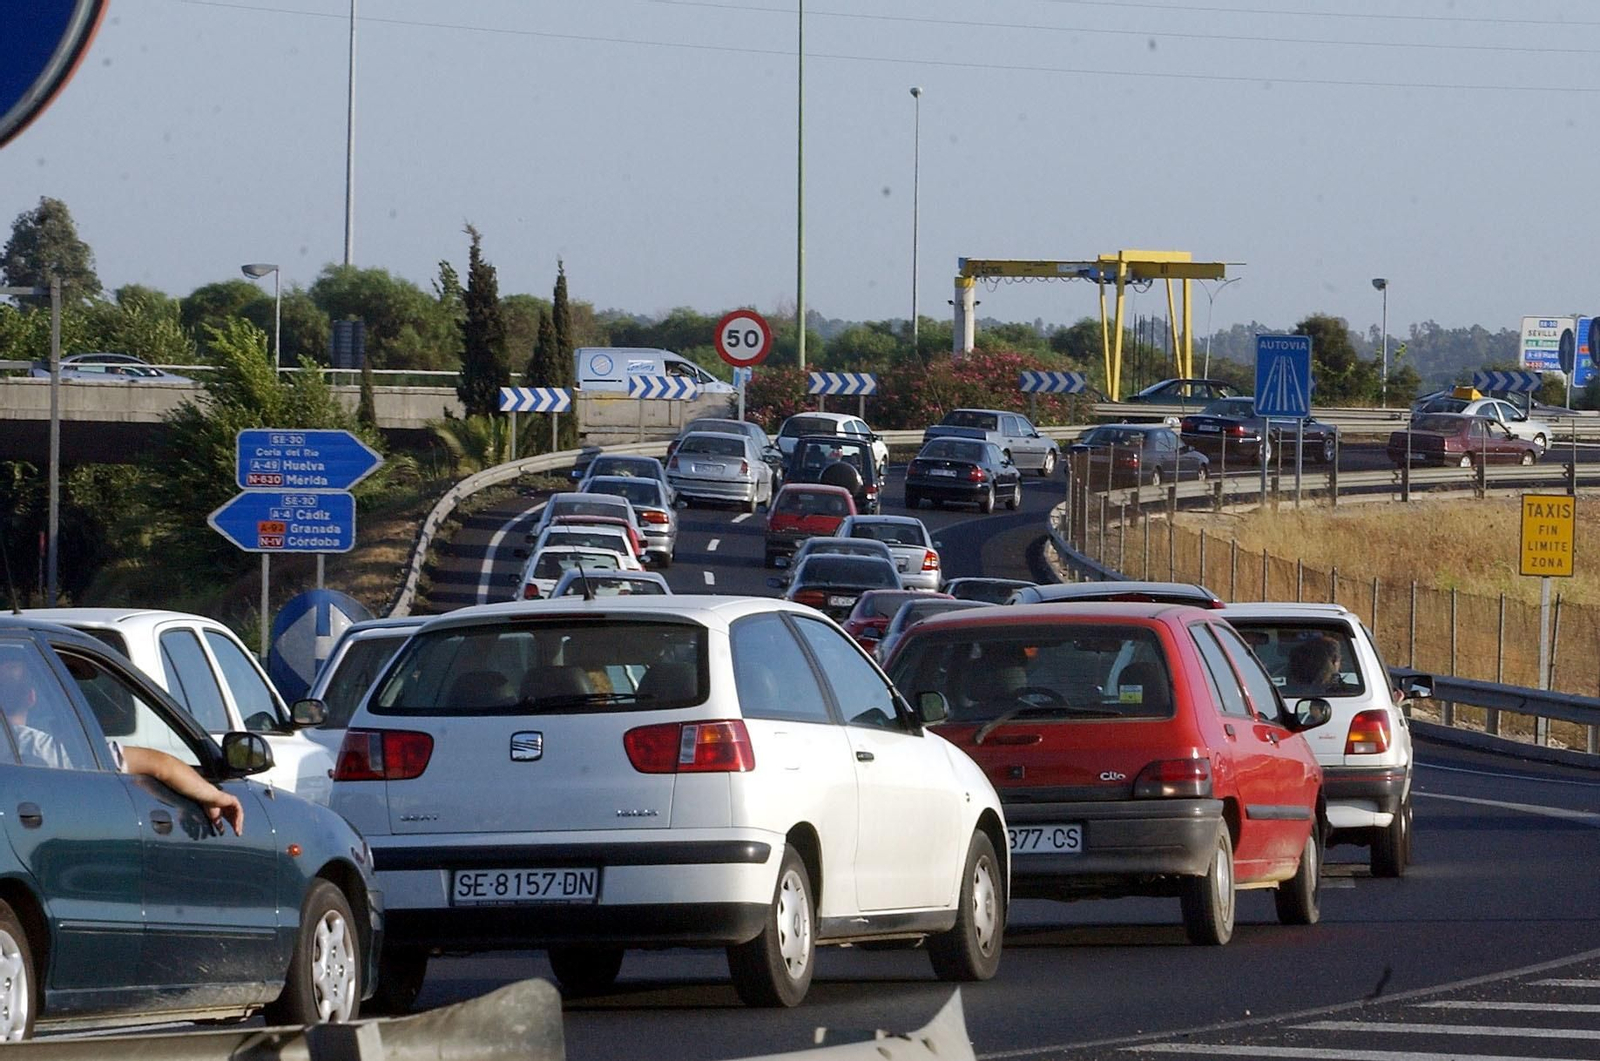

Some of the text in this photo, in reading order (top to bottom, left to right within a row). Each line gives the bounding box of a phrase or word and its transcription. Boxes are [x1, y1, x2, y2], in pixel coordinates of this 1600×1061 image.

[727, 329, 759, 348] 50
[1260, 340, 1308, 350] AUTOVIA
[272, 435, 303, 444] SE-30
[256, 447, 281, 456] Coria
[286, 447, 299, 456] del
[253, 460, 325, 471] A-49 Huelva
[249, 475, 281, 484] N-630
[285, 497, 315, 505] SE-30
[273, 510, 290, 518] A-4
[1527, 503, 1571, 518] TAXIS
[290, 523, 341, 534] Granada
[1538, 525, 1558, 535] FIN
[260, 538, 282, 546] N-IV
[1527, 541, 1567, 552] LIMITE
[1531, 557, 1563, 568] ZONA
